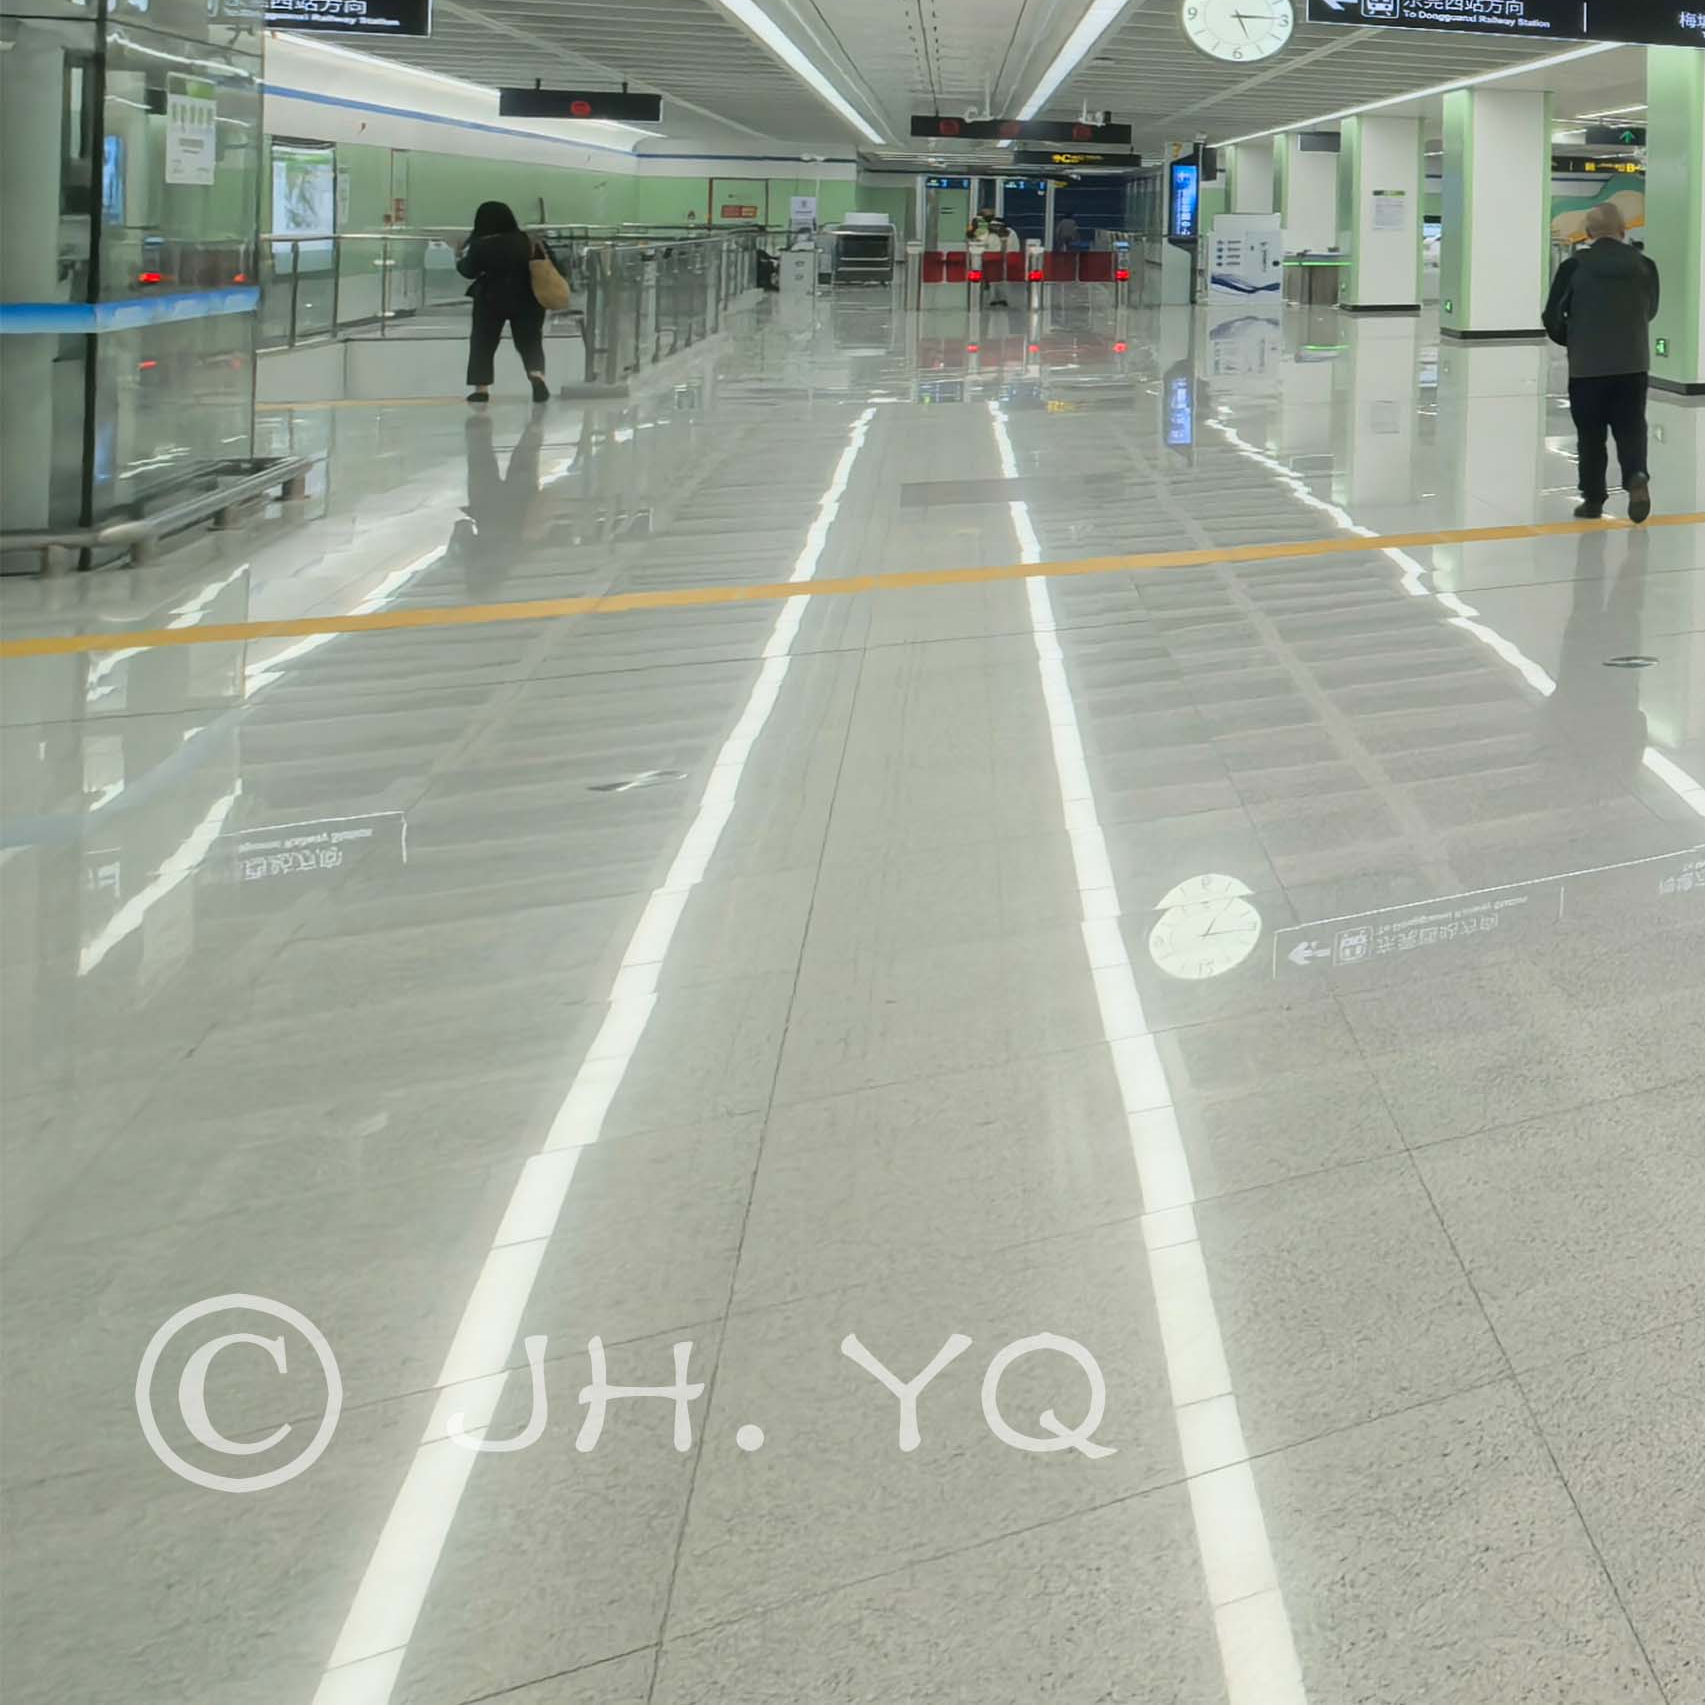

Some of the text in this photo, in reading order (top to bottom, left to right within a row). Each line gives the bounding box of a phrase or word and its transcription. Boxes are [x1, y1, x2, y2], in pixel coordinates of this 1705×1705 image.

[1187, 7, 1198, 20] 9
[1403, 9, 1417, 18] To
[1517, 18, 1551, 29] Station
[1232, 47, 1243, 59] 6
